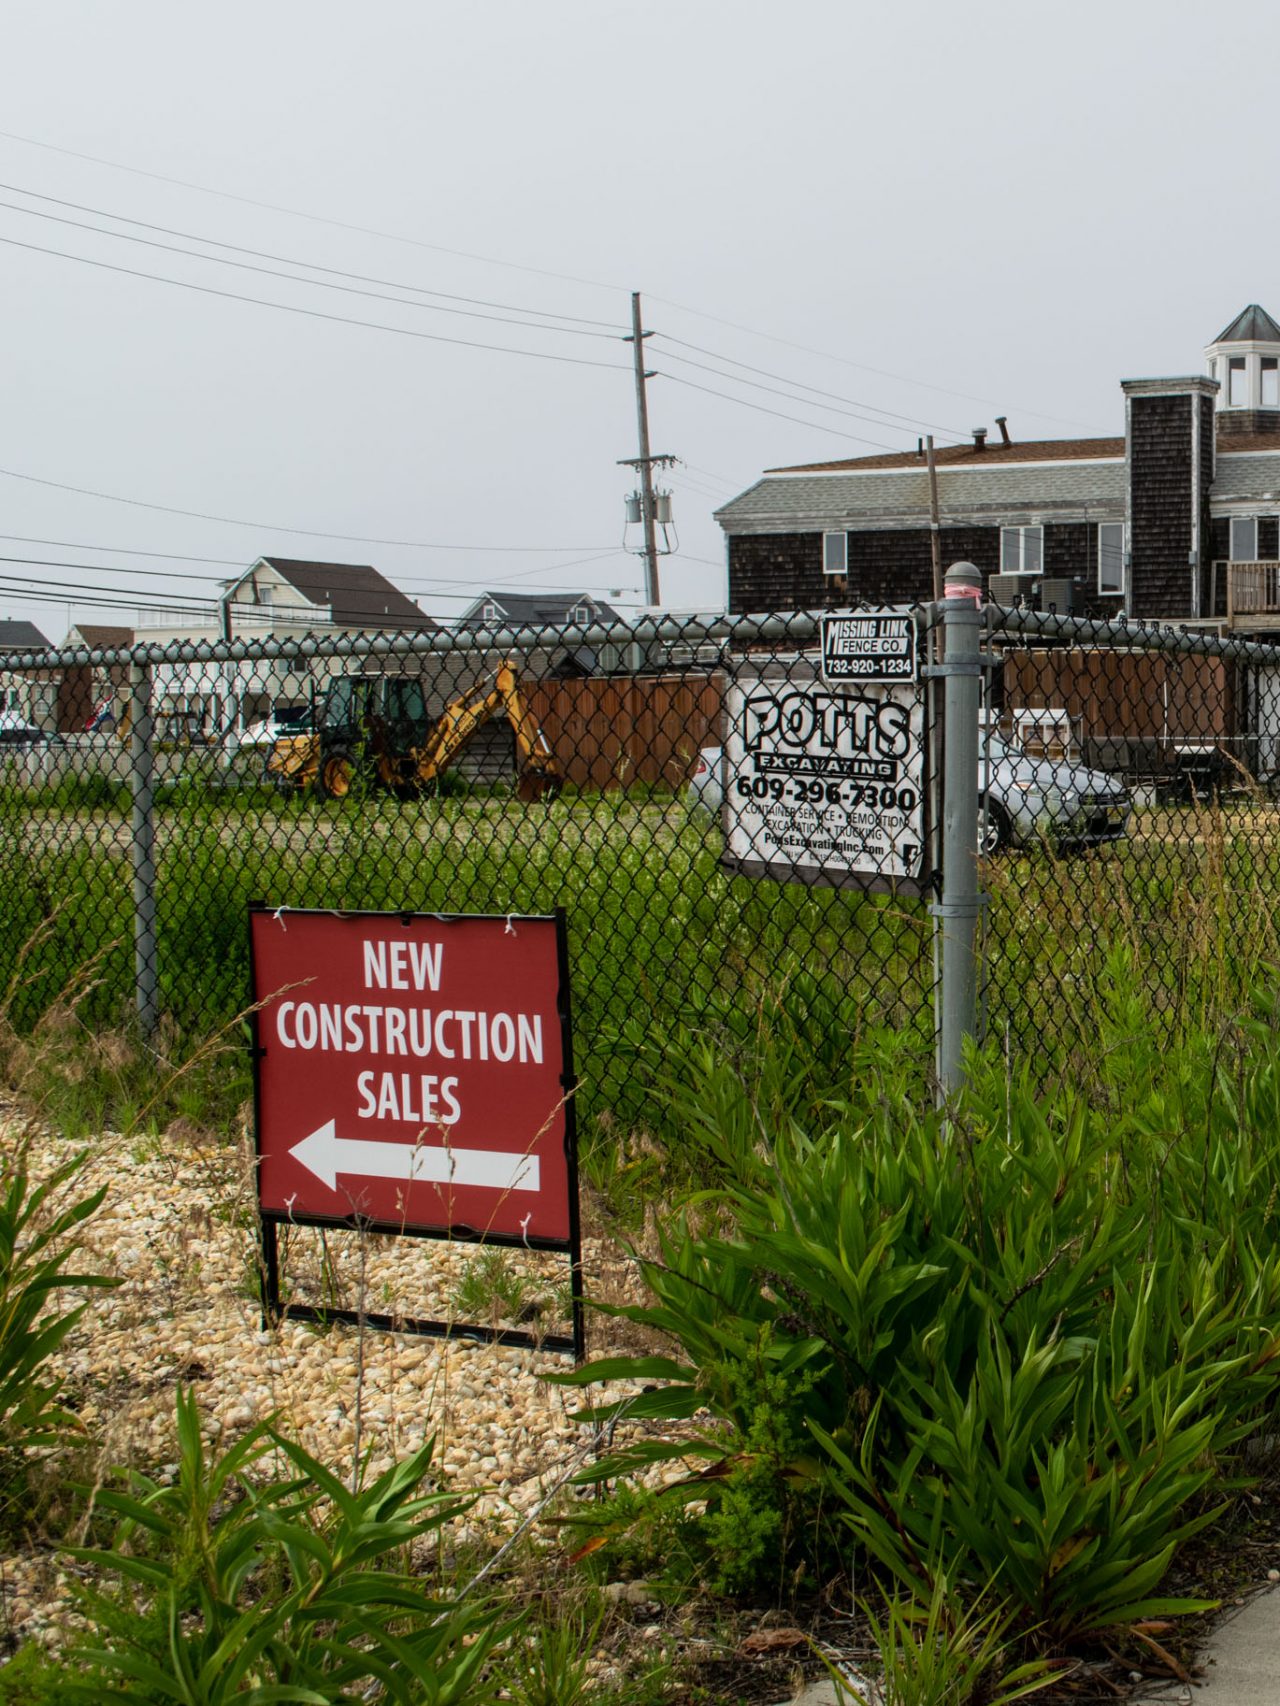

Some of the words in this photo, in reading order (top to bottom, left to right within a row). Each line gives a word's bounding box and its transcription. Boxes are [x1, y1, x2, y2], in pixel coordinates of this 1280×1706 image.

[825, 620, 877, 655] MISSING
[879, 620, 909, 637] LINK
[842, 640, 878, 653] FENCE
[881, 640, 903, 653] CO.
[826, 659, 912, 674] 732-920-1234
[743, 692, 911, 760] POTTS
[760, 755, 893, 776] EXCAVATING
[737, 775, 917, 811] 609-296-7300
[846, 812, 906, 828] EMOITION
[363, 940, 444, 991] NEW
[276, 1001, 545, 1064] CONSTRUCTION
[356, 1070, 462, 1125] SALES
